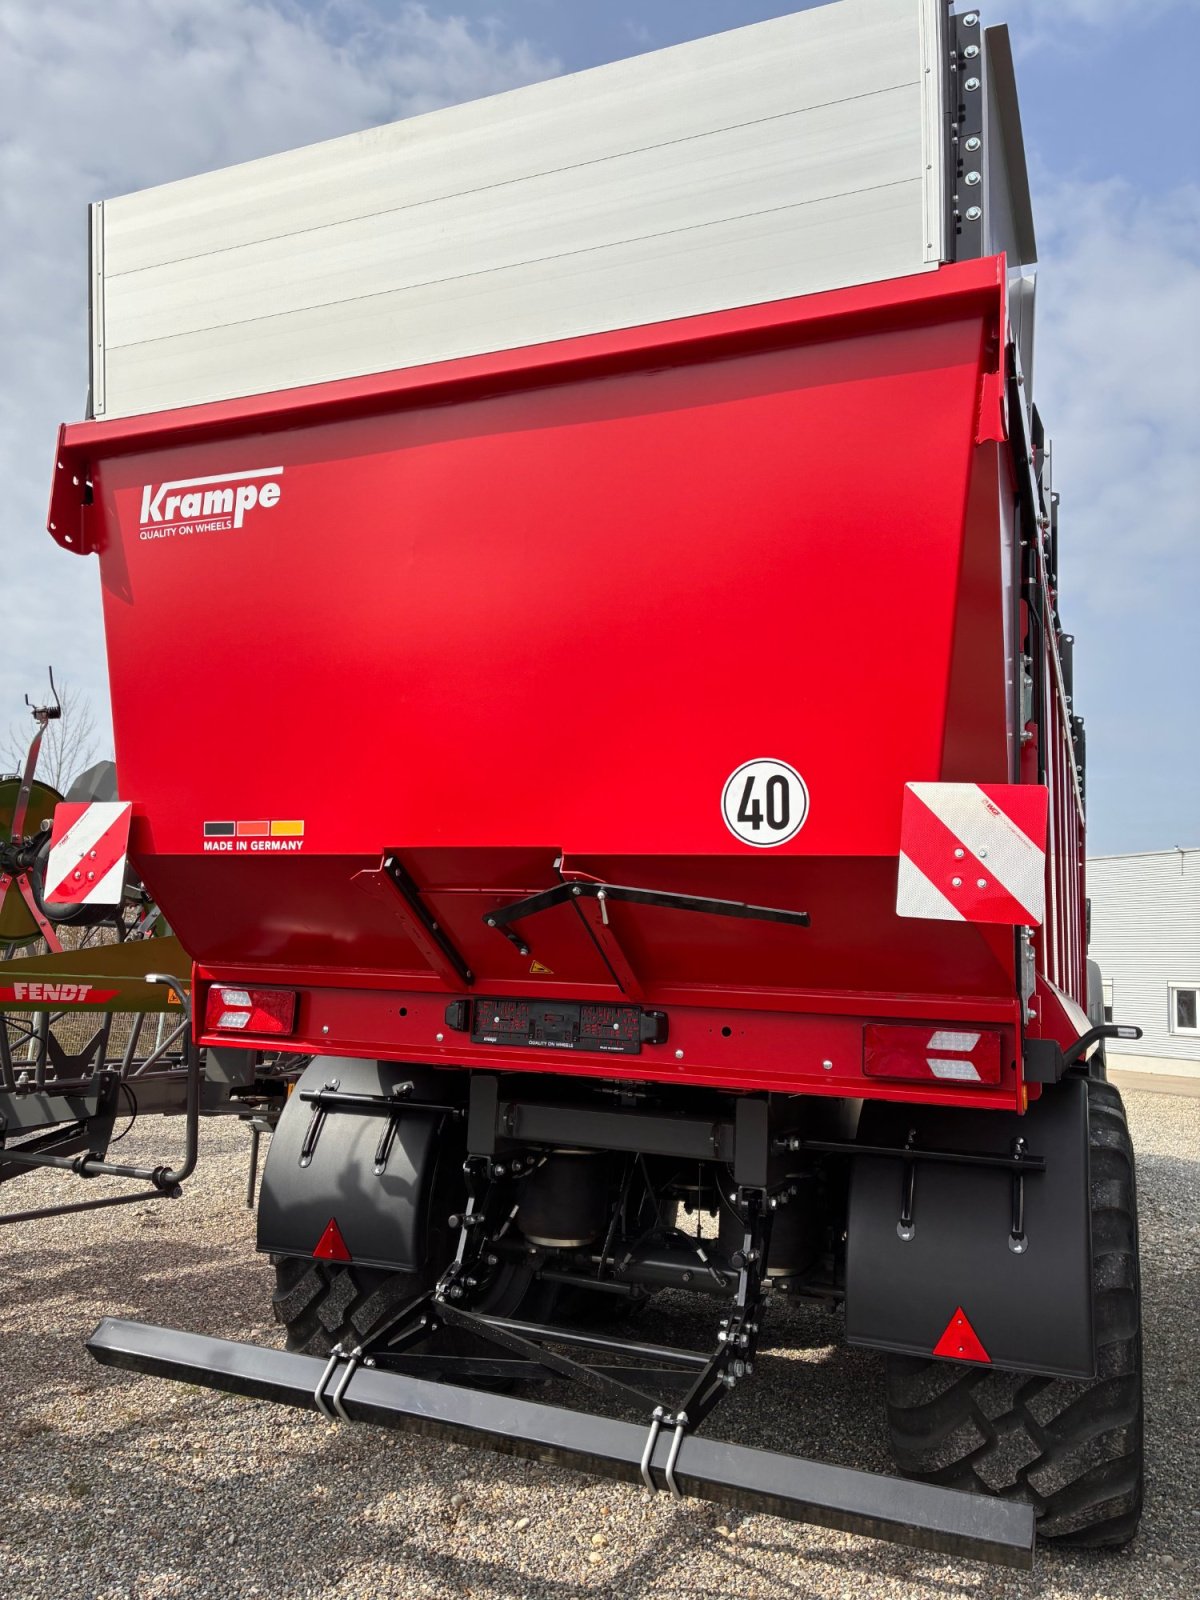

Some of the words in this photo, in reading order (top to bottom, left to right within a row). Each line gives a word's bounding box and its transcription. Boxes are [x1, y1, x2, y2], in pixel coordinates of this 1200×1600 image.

[140, 466, 283, 528] Krampe
[140, 528, 176, 540] QUALITY
[178, 525, 193, 535] ON
[195, 520, 232, 533] WHEELS
[737, 774, 790, 831] 40
[203, 841, 233, 851] MADE
[236, 841, 247, 851] IN
[250, 840, 304, 851] GERMANY
[13, 982, 93, 1002] FENDT
